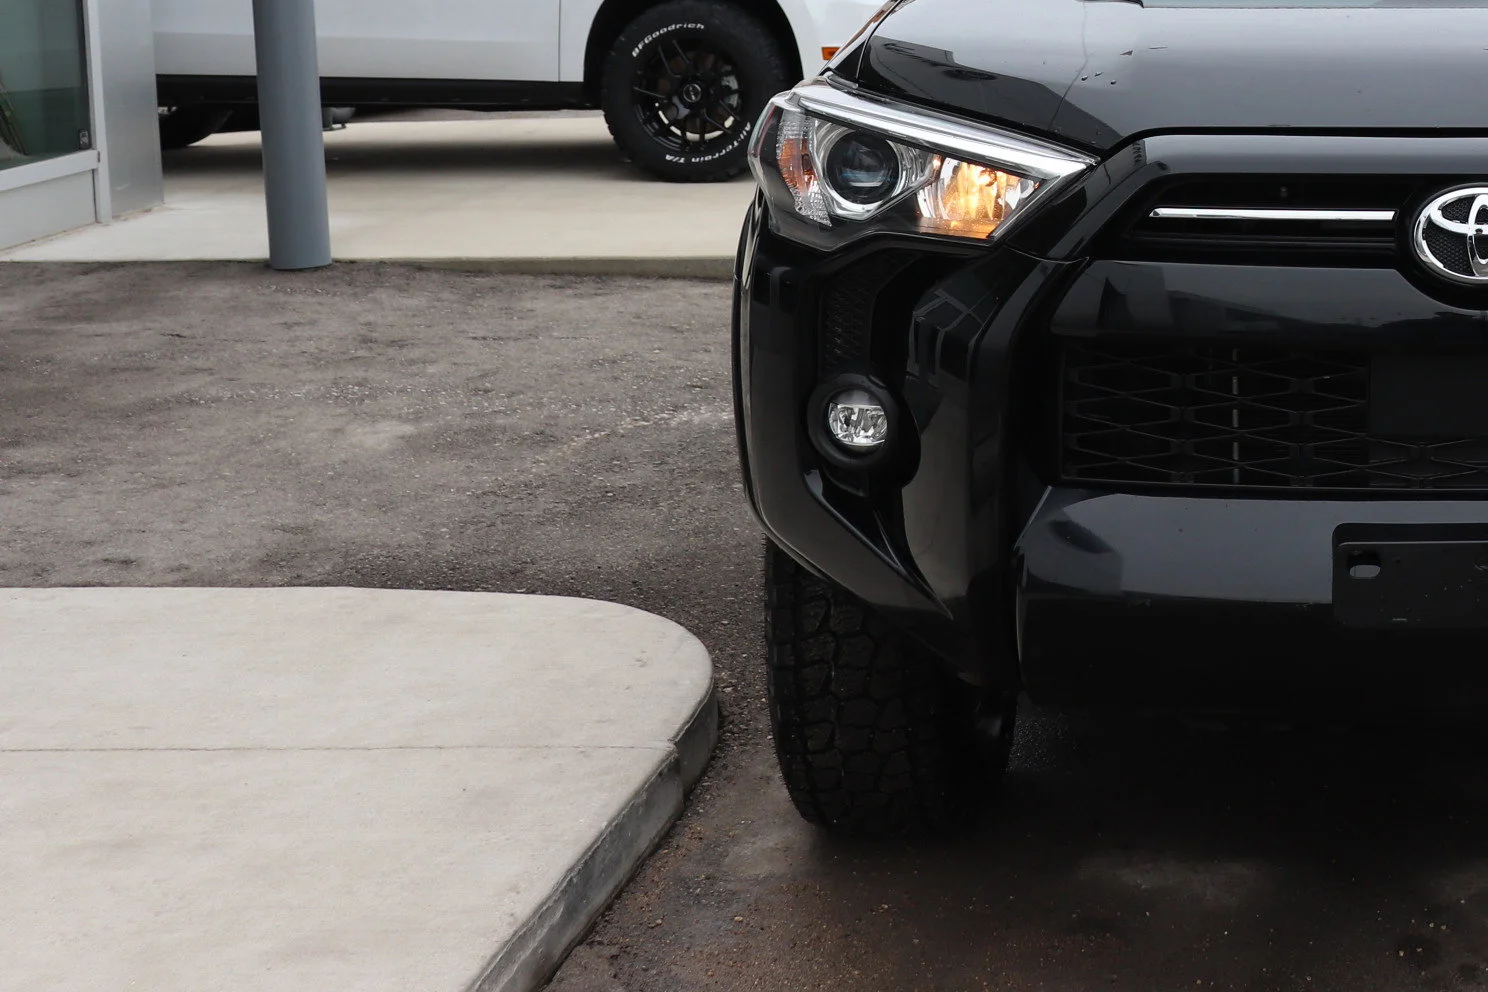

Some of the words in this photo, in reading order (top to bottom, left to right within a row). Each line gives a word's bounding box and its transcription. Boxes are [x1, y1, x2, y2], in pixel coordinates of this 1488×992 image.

[631, 22, 705, 58] BFGoodrich
[665, 154, 685, 164] T/A
[691, 121, 751, 163] All-Terrain
